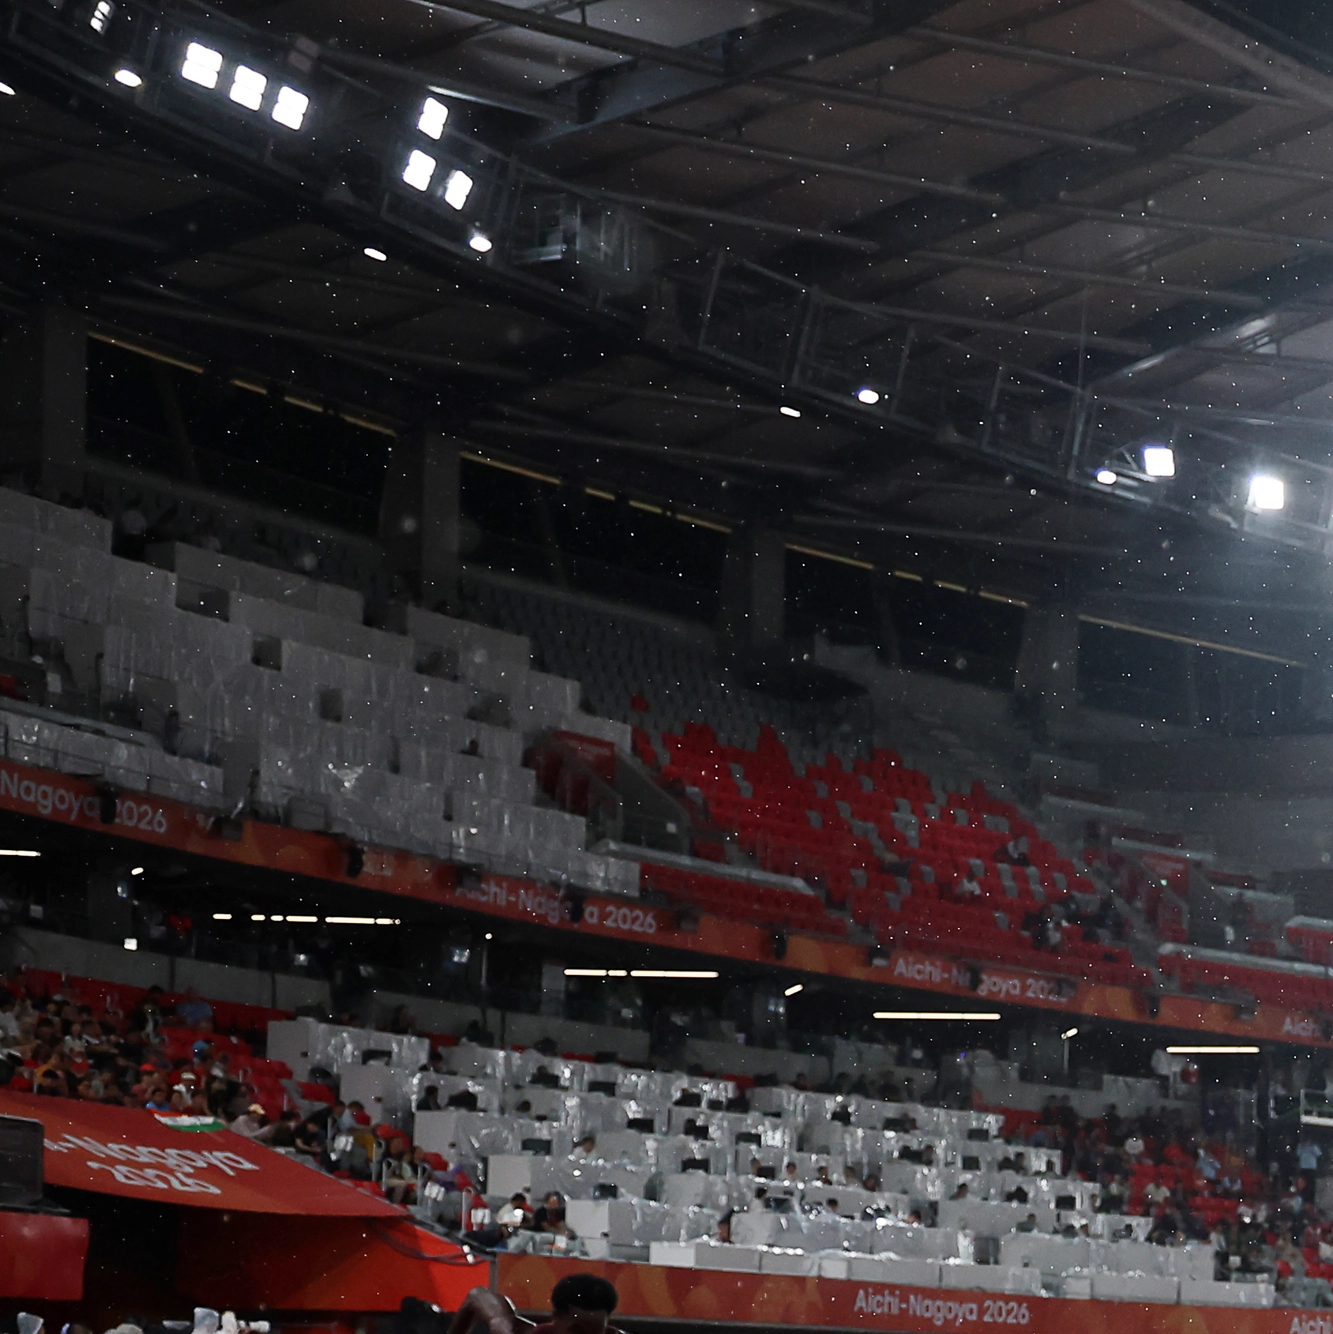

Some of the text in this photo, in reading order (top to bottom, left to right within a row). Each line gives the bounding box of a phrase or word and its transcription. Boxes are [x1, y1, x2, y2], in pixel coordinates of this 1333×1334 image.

[114, 800, 167, 833] 026
[605, 905, 657, 934] 2026
[86, 1161, 221, 1195] 2026
[854, 1287, 1030, 1326] Aichi-Nagoya 2026
